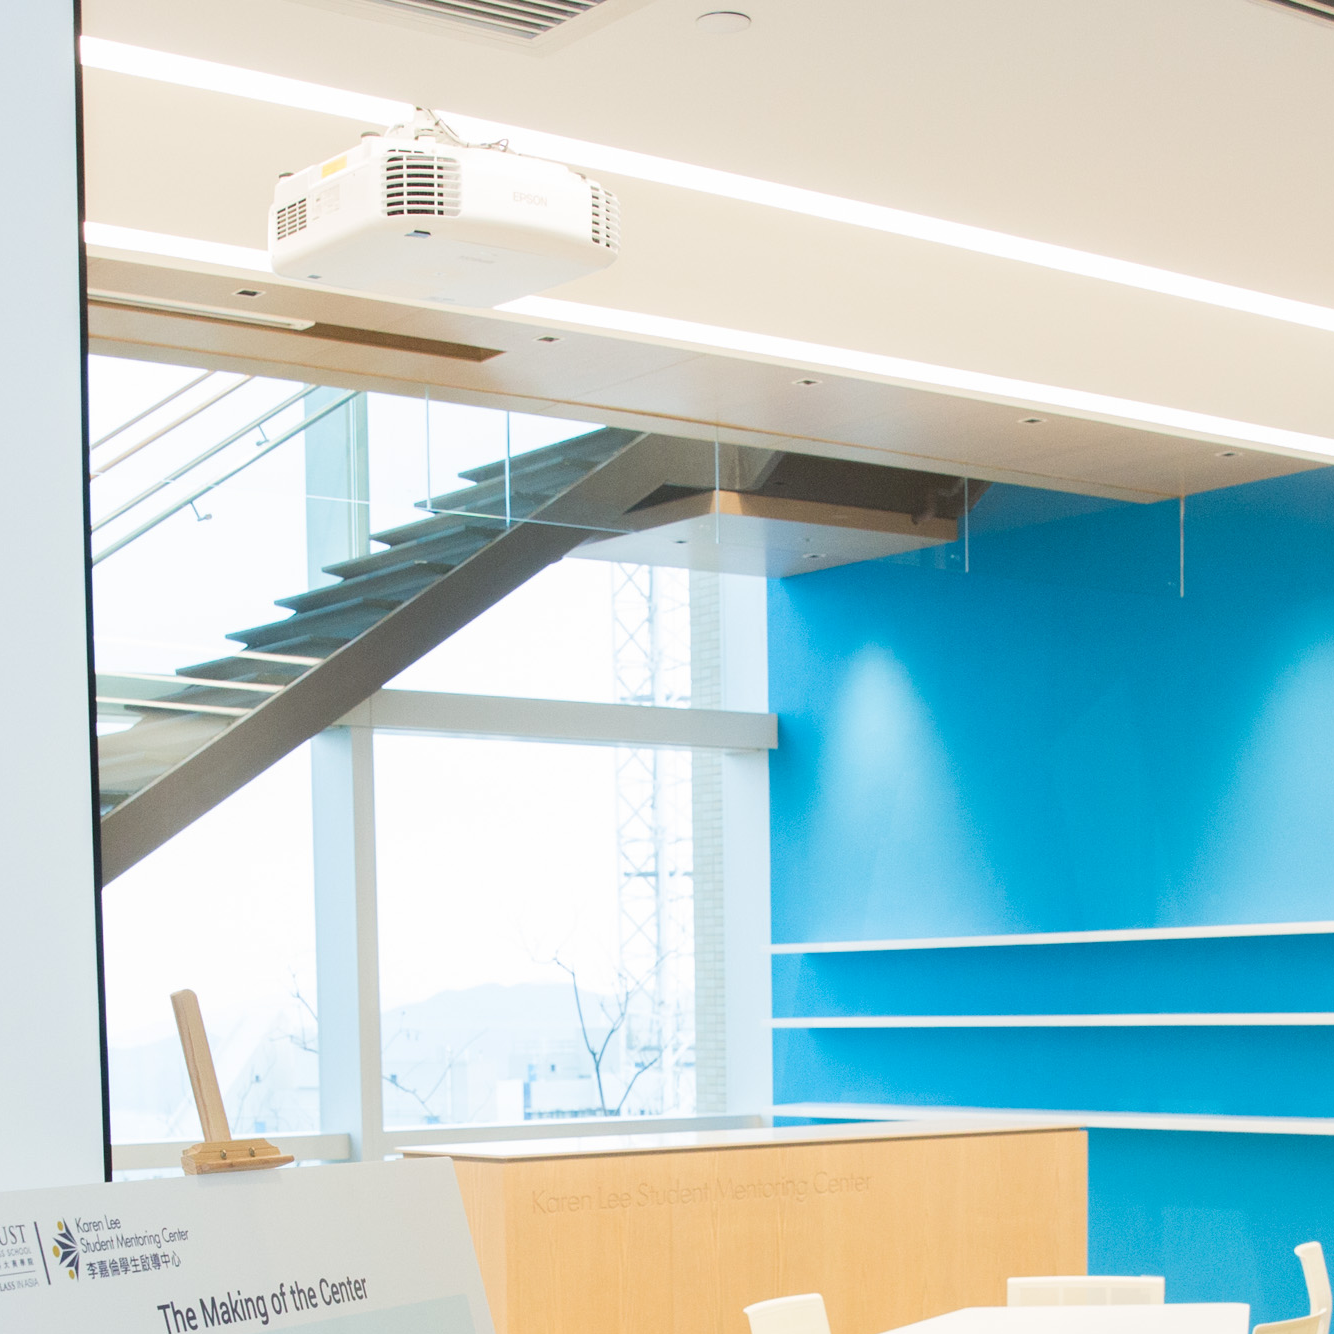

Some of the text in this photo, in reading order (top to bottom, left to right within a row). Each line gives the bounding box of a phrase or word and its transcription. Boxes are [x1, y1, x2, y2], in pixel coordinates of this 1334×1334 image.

[512, 191, 547, 208] EPSON
[532, 1170, 872, 1214] Karen Lee Student Mentoring Center
[75, 1214, 121, 1233] Karen Lee
[7, 1247, 31, 1256] SCHOOL
[80, 1228, 189, 1253] Student Mentoring Center
[157, 1275, 368, 1334] The Making of the Center
